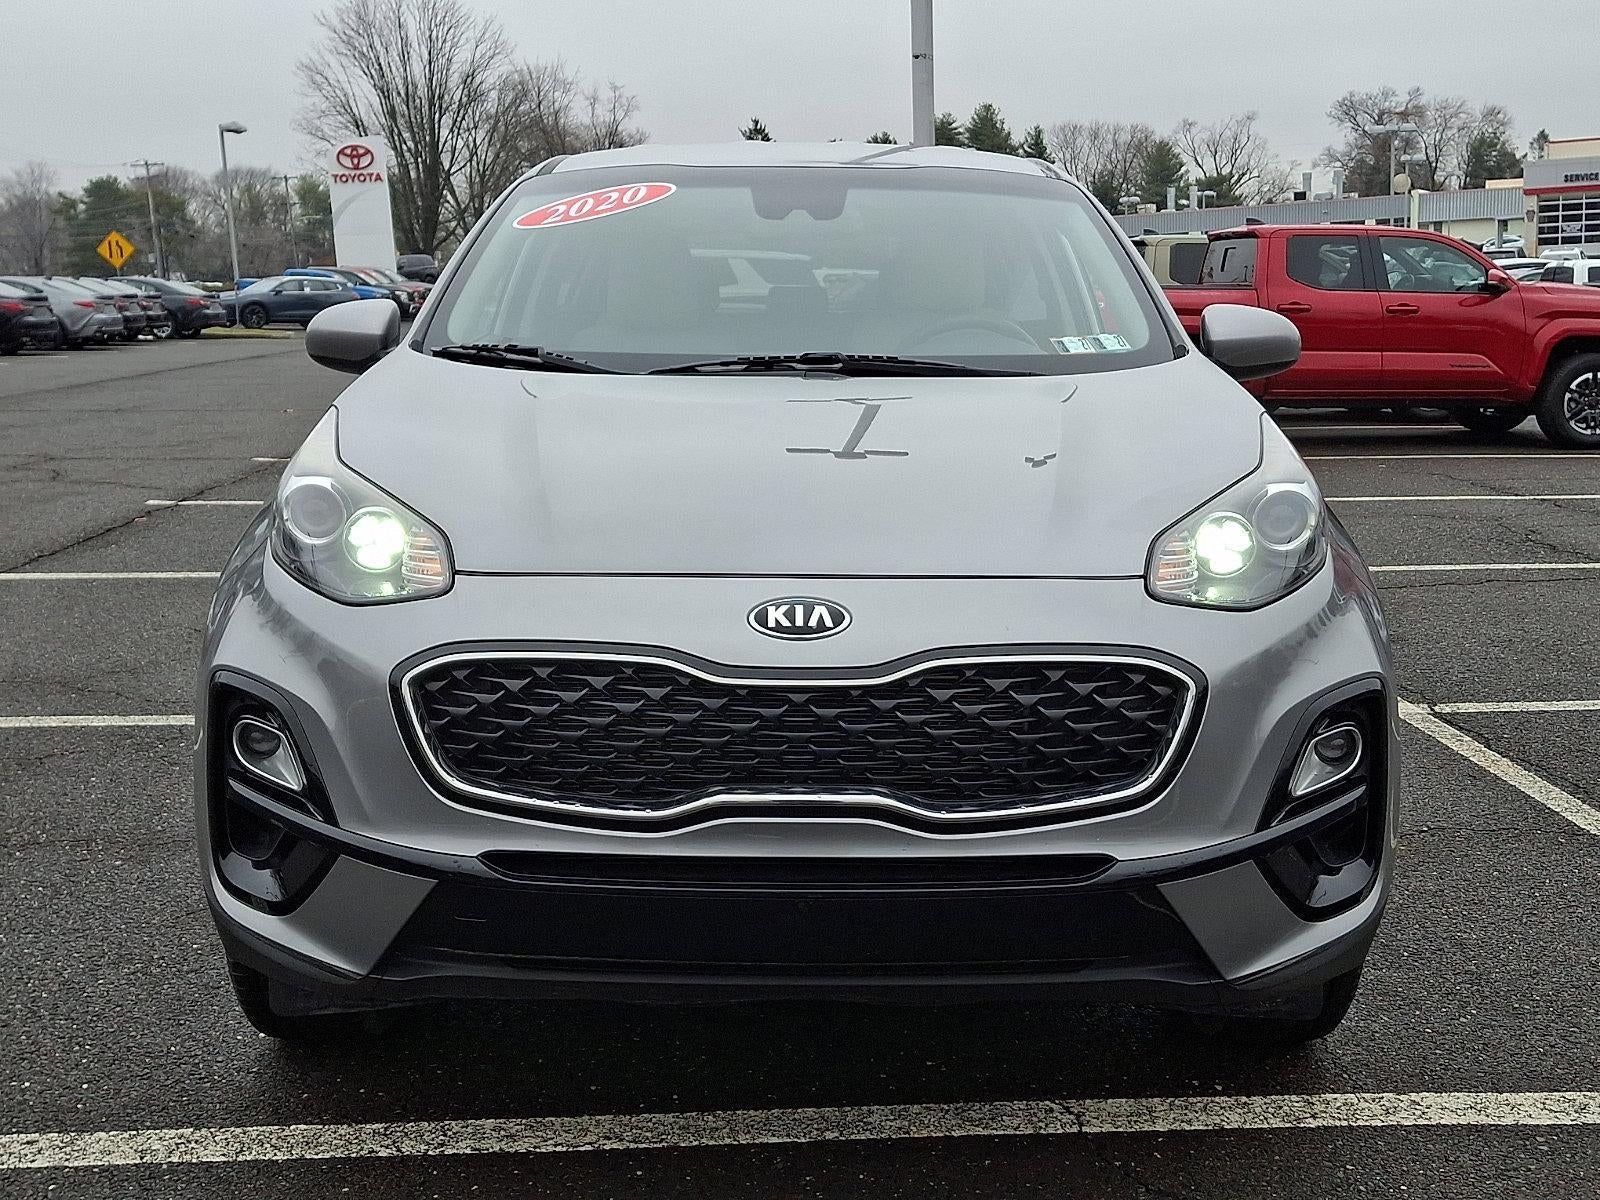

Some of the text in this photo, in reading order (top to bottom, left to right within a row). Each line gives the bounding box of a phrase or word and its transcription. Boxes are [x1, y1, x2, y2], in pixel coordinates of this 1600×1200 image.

[331, 172, 383, 184] TOYOTA
[1563, 172, 1600, 183] SERVICE
[541, 185, 648, 225] 2020
[766, 604, 835, 628] KIA
